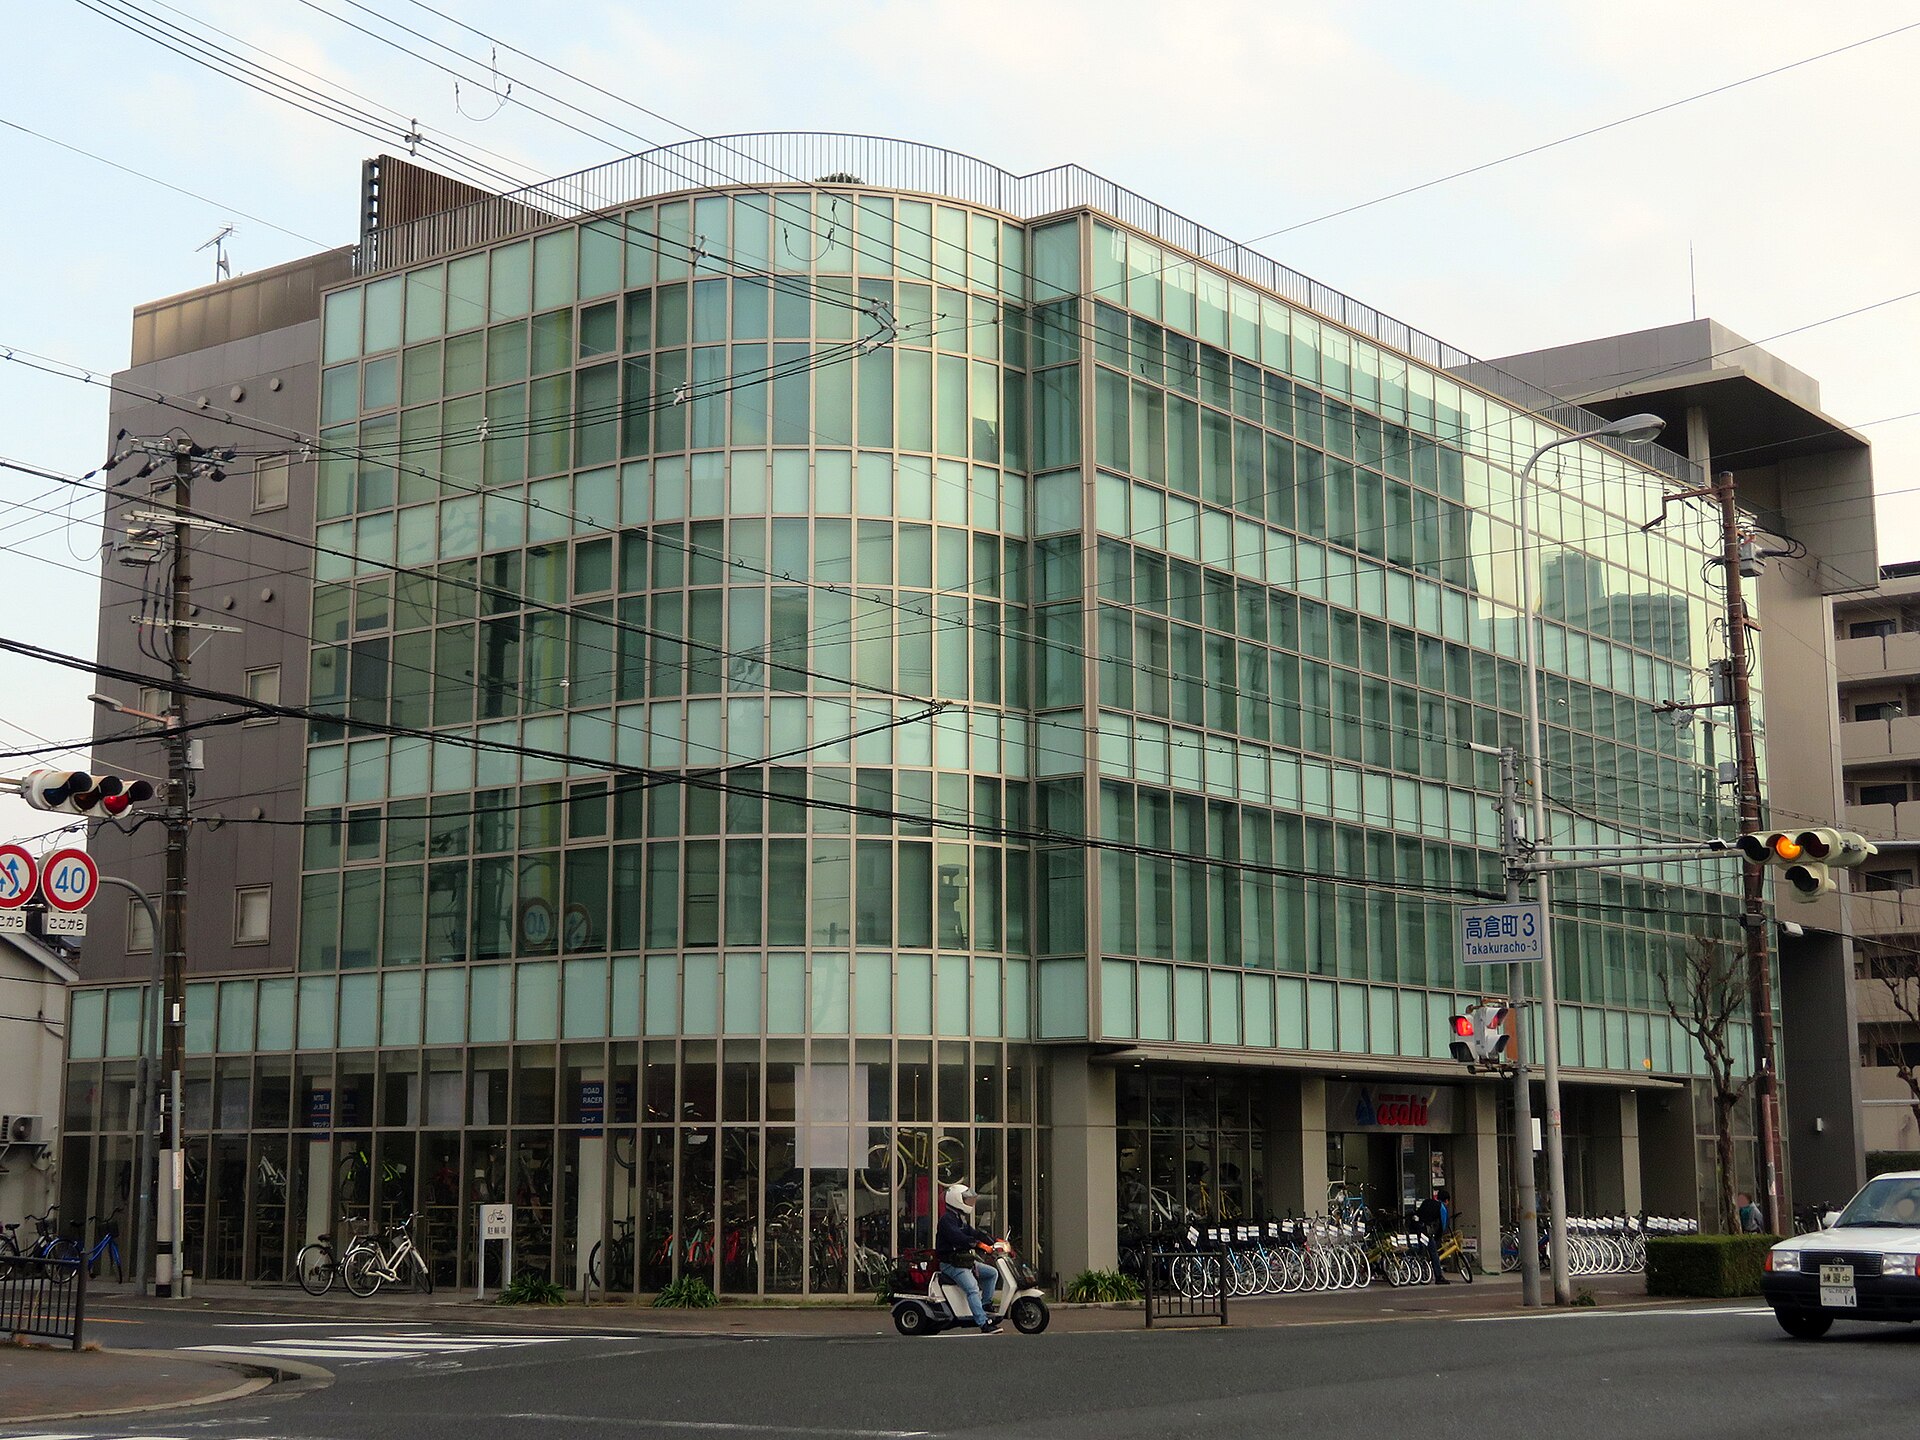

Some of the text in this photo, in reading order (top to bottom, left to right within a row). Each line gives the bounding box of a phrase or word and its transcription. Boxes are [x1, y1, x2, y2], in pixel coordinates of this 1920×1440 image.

[55, 866, 86, 894] 40
[49, 918, 84, 931] ここから
[1465, 940, 1538, 955] Takakuracho-3
[582, 1087, 600, 1095] ROAD
[582, 1096, 603, 1104] RACER
[1377, 1095, 1428, 1126] asahi
